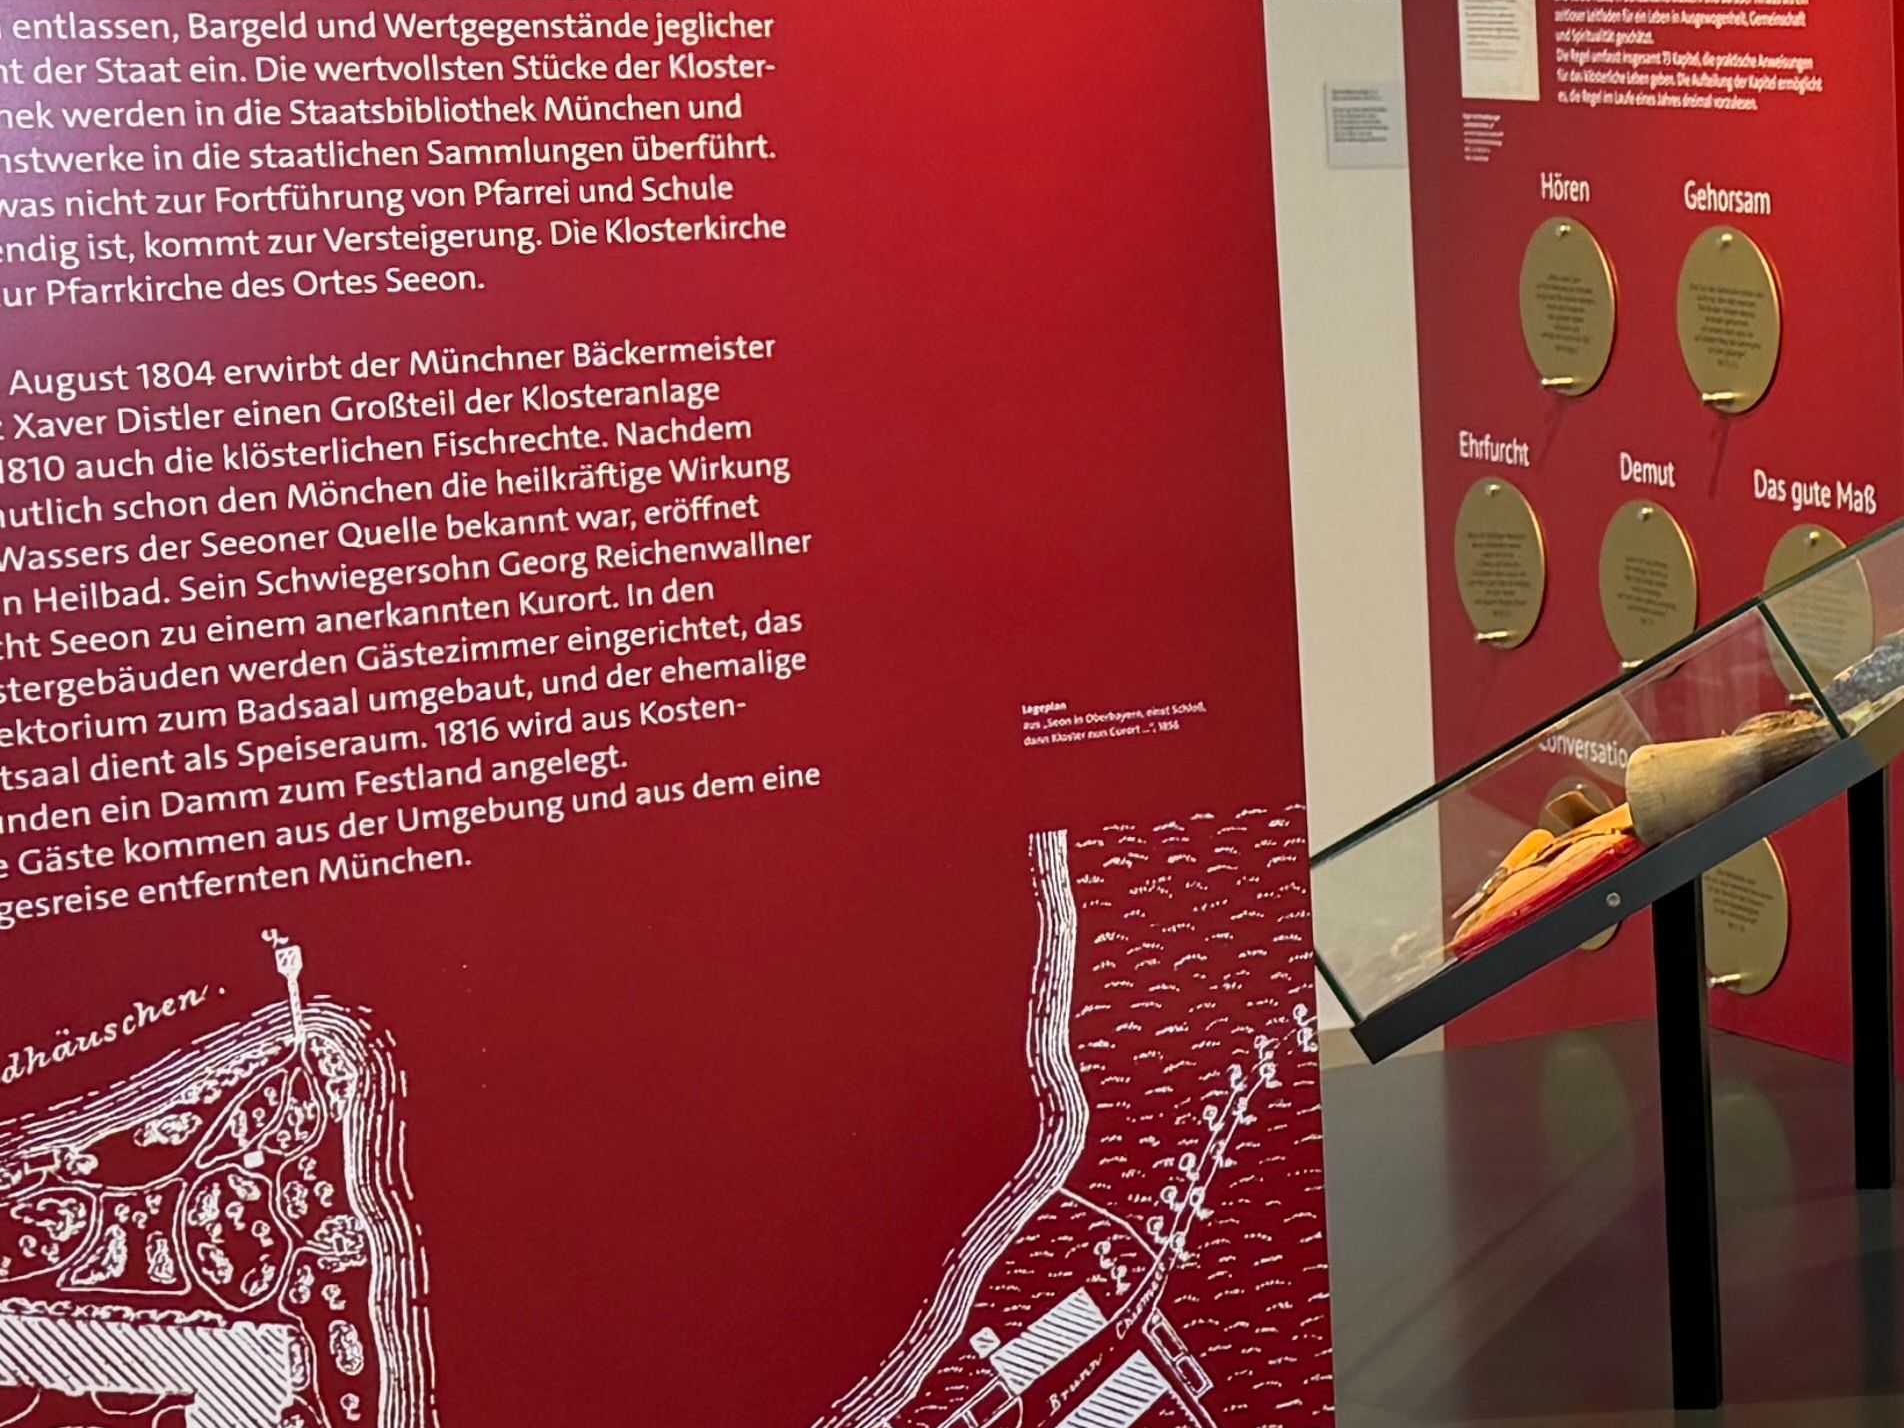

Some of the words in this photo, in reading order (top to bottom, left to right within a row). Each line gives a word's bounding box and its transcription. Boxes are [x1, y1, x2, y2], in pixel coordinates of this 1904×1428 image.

[13, 12, 178, 43] entlassen,
[189, 11, 307, 47] Bargeld
[317, 11, 376, 38] und
[384, 12, 648, 46] Wertgegenstände
[654, 12, 774, 45] jeglicher
[1541, 172, 1589, 201] Hören
[1684, 180, 1770, 214] Gehorsam
[10, 365, 129, 401] August
[136, 361, 215, 389] 1804
[224, 354, 342, 384] erwirbt
[351, 352, 400, 378] der
[411, 345, 564, 375] Münchner
[573, 336, 775, 367] Bäckermeister
[1459, 431, 1529, 466] Ehrfurcht
[1620, 452, 1675, 487] Demut
[1754, 469, 1786, 501] Das
[1792, 481, 1831, 511] gute
[1837, 481, 1876, 514] Maß
[34, 577, 170, 613] Heilbad.
[180, 574, 246, 601] Sein
[257, 555, 489, 595] Schwiegersohn
[499, 552, 588, 578] Georg
[597, 531, 811, 569] Reichenwallner
[139, 866, 308, 903] entfernten
[320, 847, 471, 882] München.
